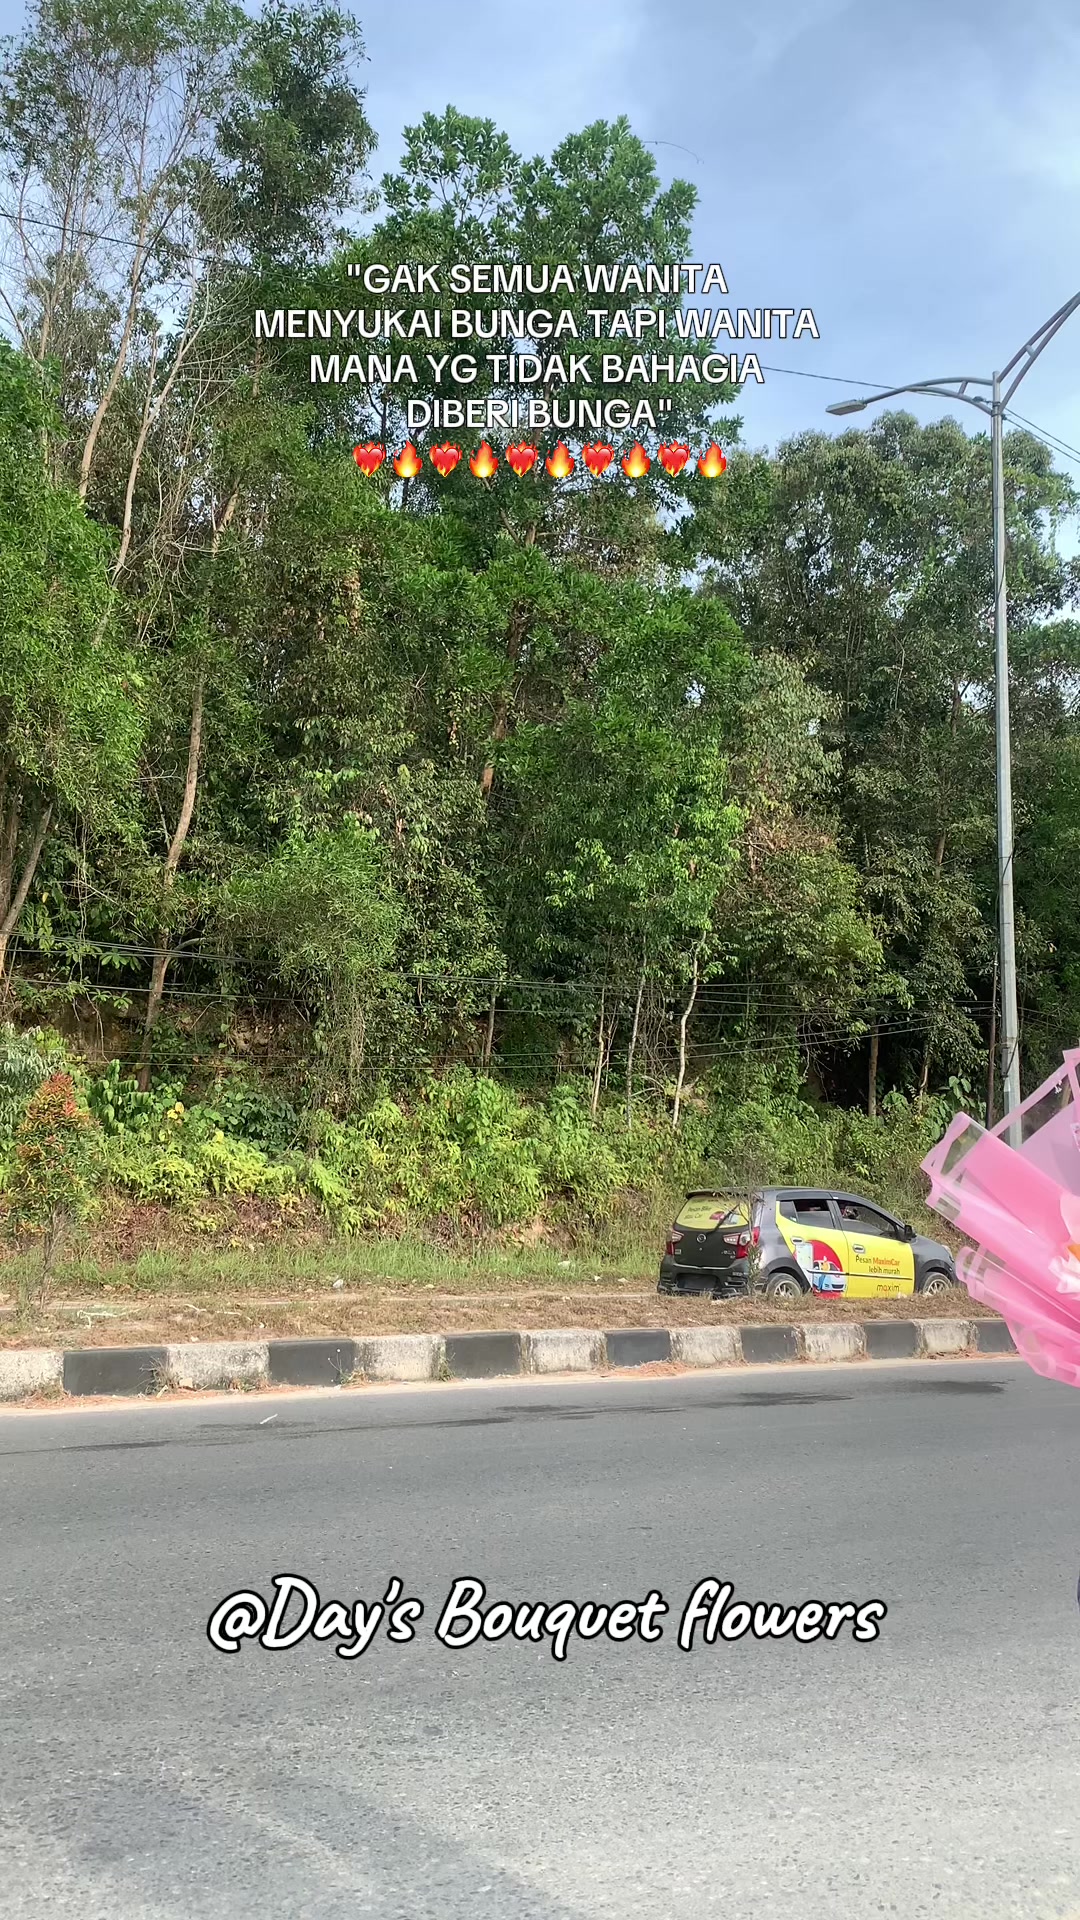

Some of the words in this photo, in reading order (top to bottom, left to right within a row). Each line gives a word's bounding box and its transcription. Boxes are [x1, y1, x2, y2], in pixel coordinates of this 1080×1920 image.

[855, 1255, 872, 1264] Pesan
[873, 1257, 900, 1266] MaximCar
[868, 1265, 882, 1273] lebih
[876, 1283, 899, 1292] maxim
